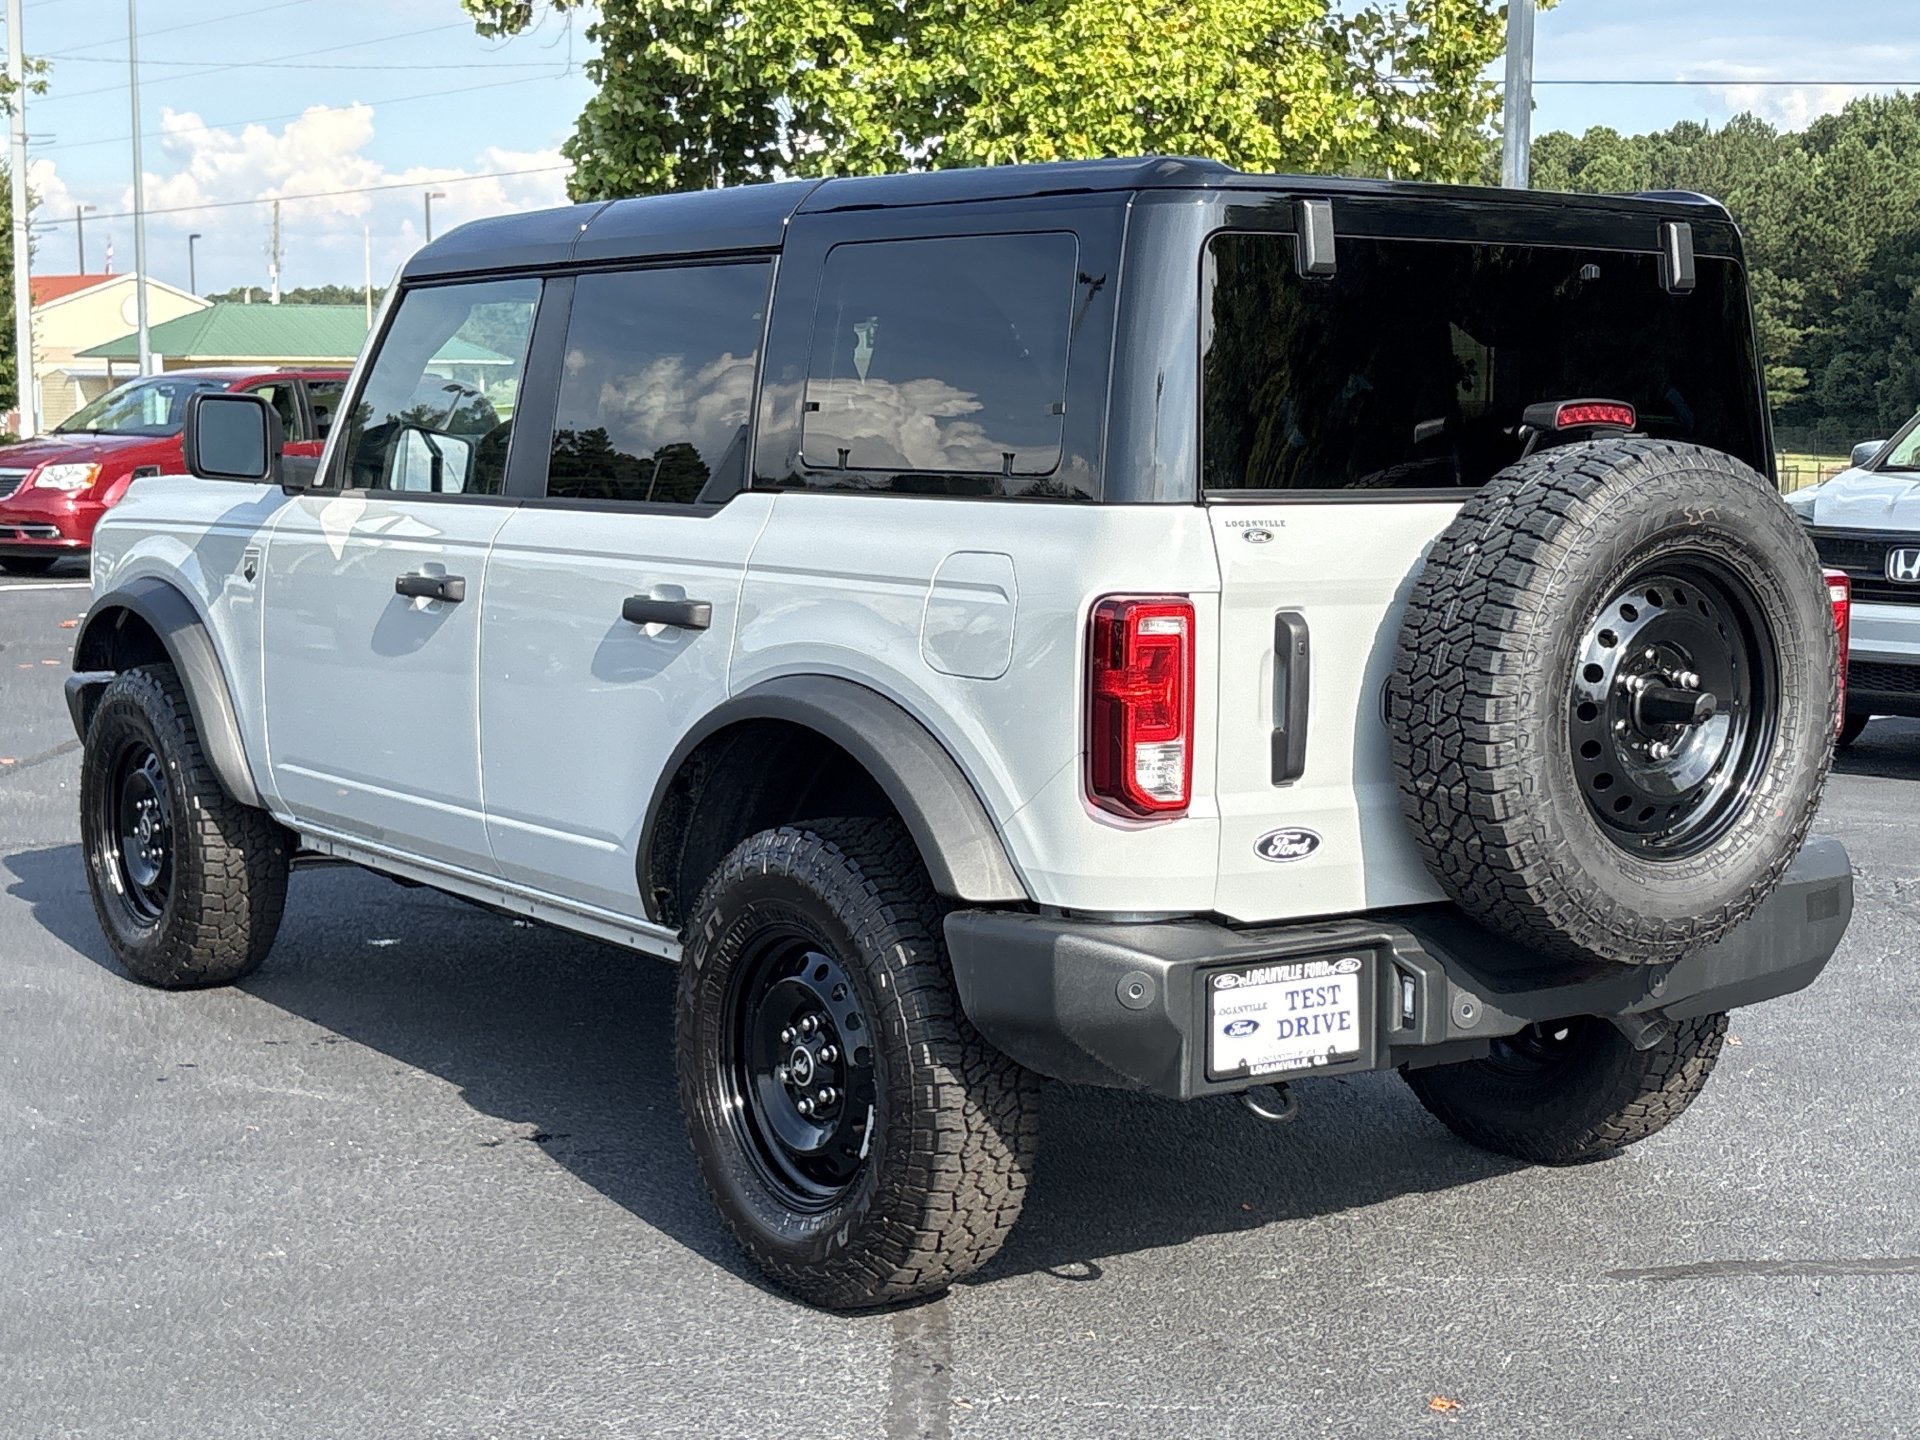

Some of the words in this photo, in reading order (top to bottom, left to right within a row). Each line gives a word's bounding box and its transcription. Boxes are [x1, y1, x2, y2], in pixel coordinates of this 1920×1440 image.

[1225, 519, 1286, 528] LOGANVILLE
[1266, 833, 1312, 857] Ford
[1246, 964, 1302, 986] LOGANVILLE
[1304, 961, 1329, 980] FORD
[1285, 984, 1341, 1012] TEST
[1277, 1011, 1351, 1040] DRIVE
[1313, 1054, 1328, 1066] GA
